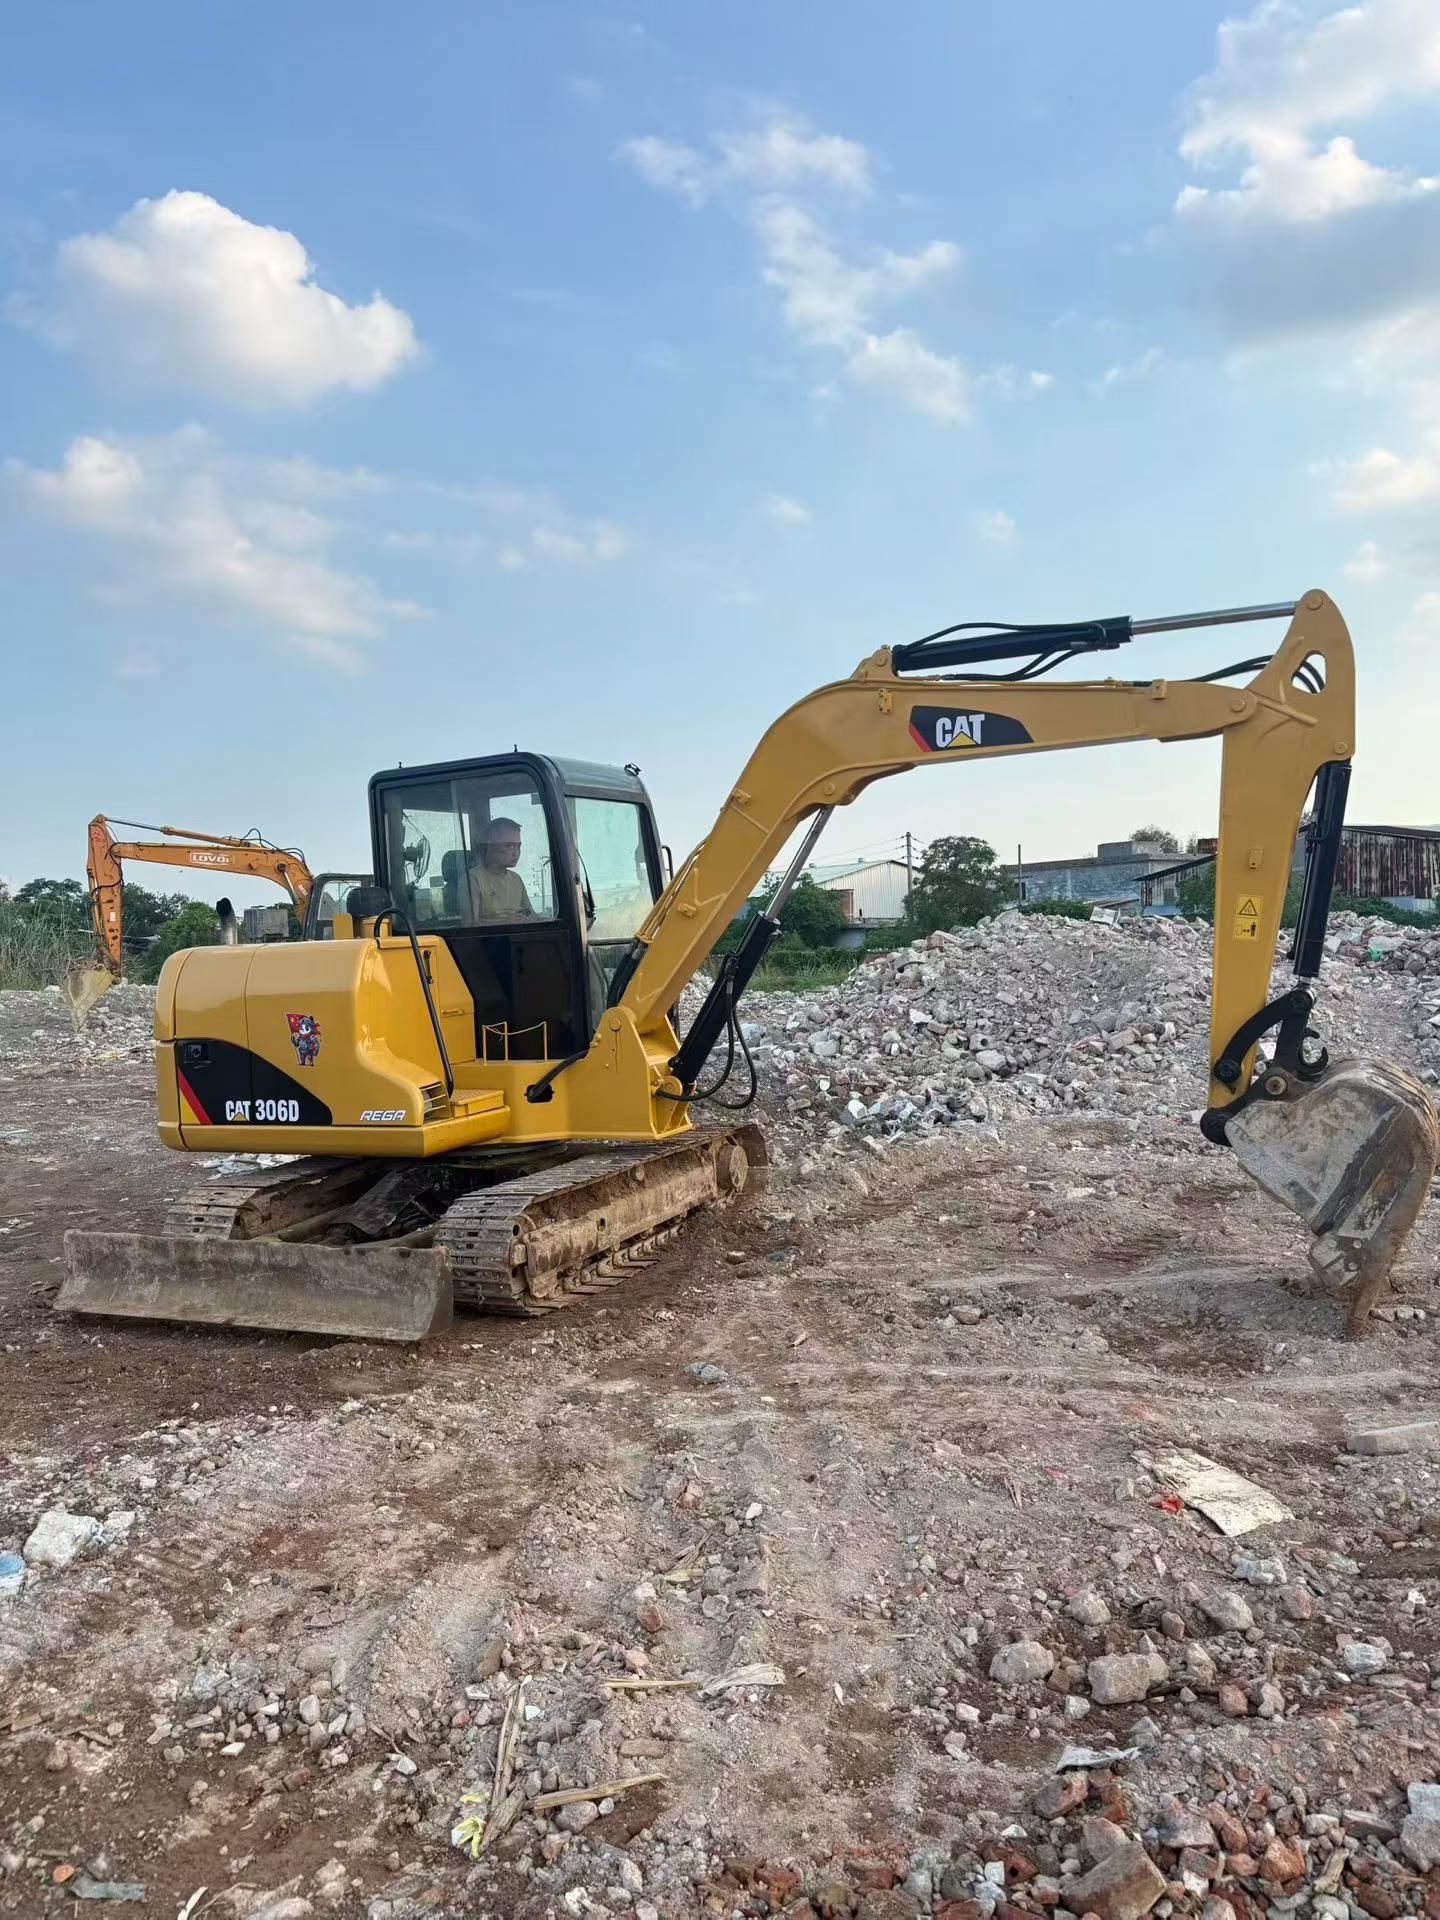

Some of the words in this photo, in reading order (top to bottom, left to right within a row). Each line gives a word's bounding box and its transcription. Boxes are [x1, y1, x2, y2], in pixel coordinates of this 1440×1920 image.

[935, 713, 985, 748] CAT
[225, 1100, 251, 1121] CAT
[255, 1099, 299, 1122] 306D
[360, 1110, 406, 1121] REGA
